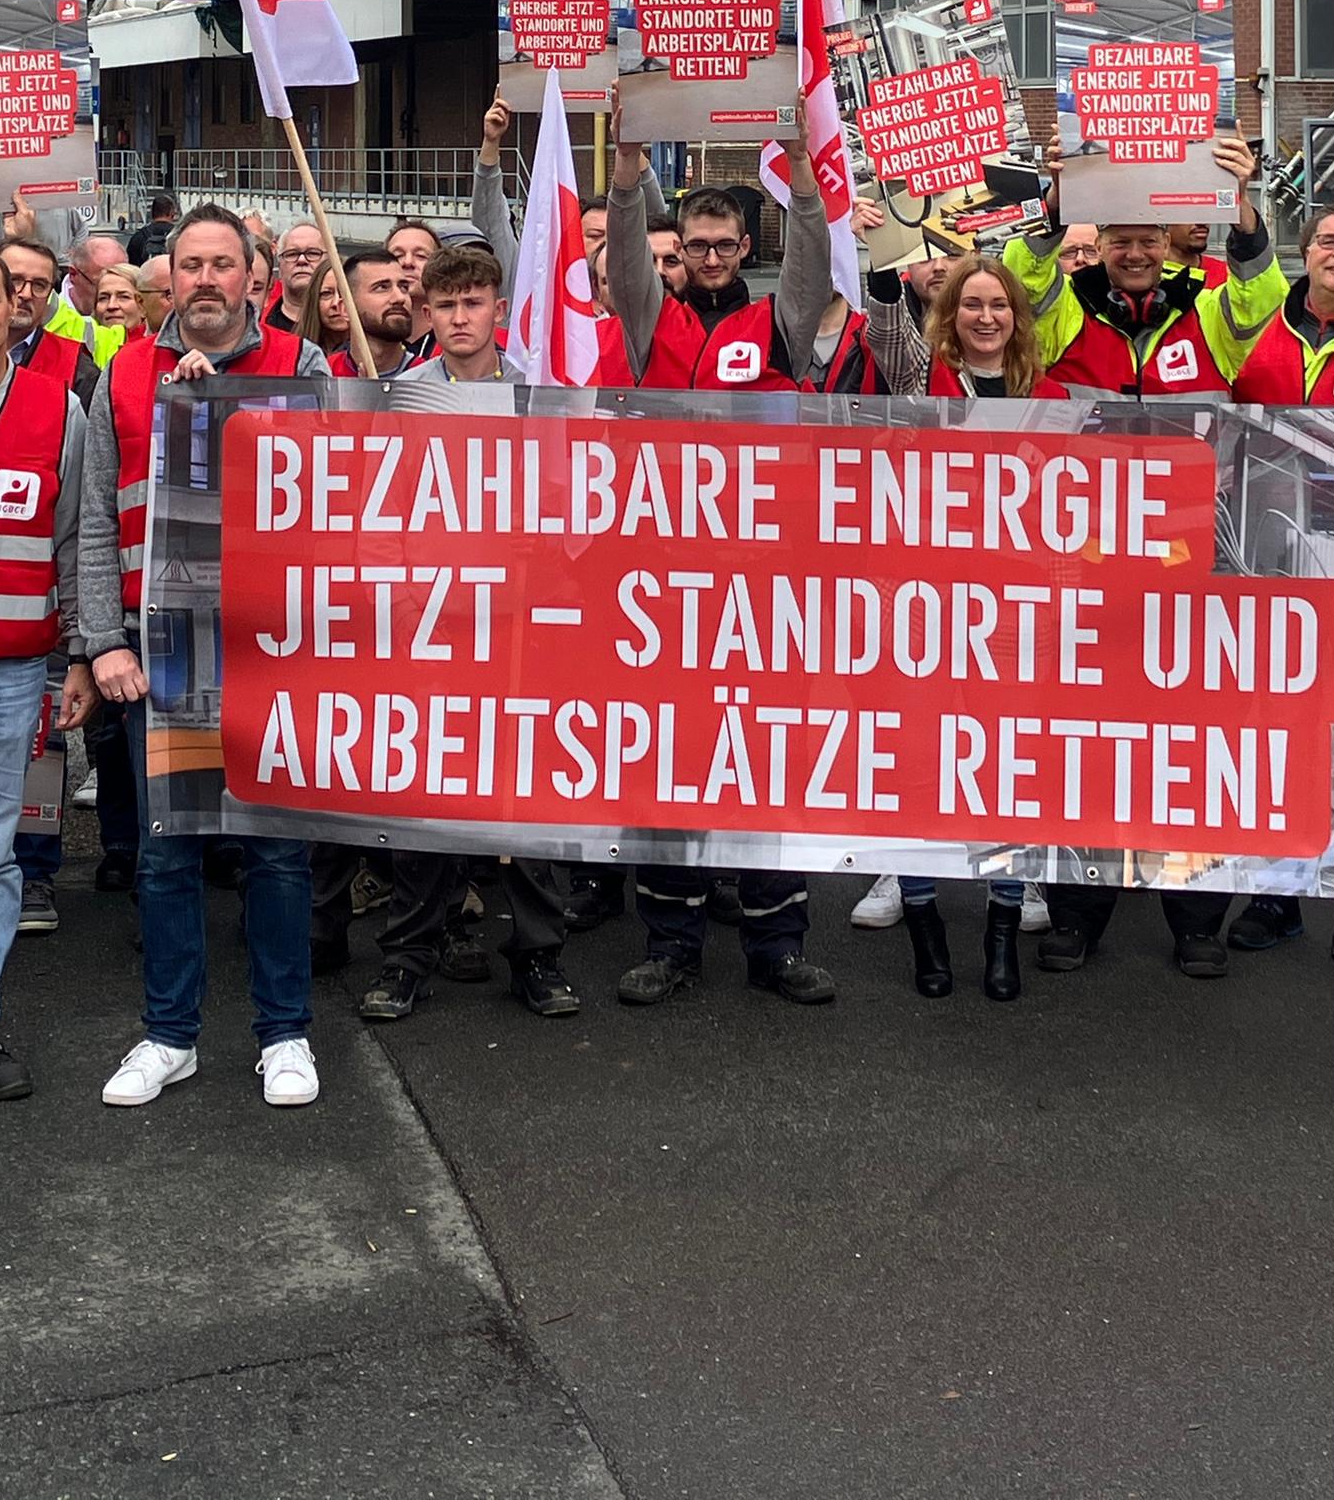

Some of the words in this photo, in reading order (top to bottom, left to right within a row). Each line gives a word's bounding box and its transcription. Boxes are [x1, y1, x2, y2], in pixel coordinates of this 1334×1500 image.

[513, 2, 557, 15] ENERGIE
[562, 2, 594, 15] JETZT
[515, 18, 581, 32] STANDORTE
[582, 19, 604, 32] UND
[642, 10, 734, 29] STANDORTE
[740, 9, 773, 28] UND
[518, 33, 601, 49] ARBEITSPLÄTZE
[647, 30, 769, 53] ARBEITSPLÄTZE
[537, 52, 581, 66] RETTEN!
[676, 57, 740, 77] RETTEN!
[1095, 47, 1194, 67] BEZAHLBARE
[17, 75, 58, 92] JETZT
[874, 62, 973, 102] BEZAHLBARE
[1077, 71, 1142, 90] ENERGIE
[1148, 70, 1196, 89] JETZT
[43, 95, 71, 111] UND
[863, 99, 928, 131] ENERGIE
[933, 86, 978, 115] JETZT
[1081, 94, 1172, 113] STANDORTE
[1178, 93, 1210, 111] UND
[870, 114, 962, 153] STANDORTE
[965, 107, 999, 131] UND
[1086, 114, 1207, 136] ARBEITSPLÄTZE
[881, 129, 1002, 176] ARBEITSPLÄTZE
[1115, 141, 1179, 159] RETTEN!
[912, 163, 978, 193] RETTEN!
[256, 435, 780, 541] BEZAHLBARE
[819, 447, 1172, 558] ENERGIE
[0, 505, 26, 514] IGBCE
[255, 566, 506, 662] JETZT
[615, 569, 1103, 686] STANDORTE
[1142, 592, 1318, 694] UND
[256, 686, 901, 813] ARBEITSPLÄTZE
[938, 713, 1289, 831] RETTEN!
